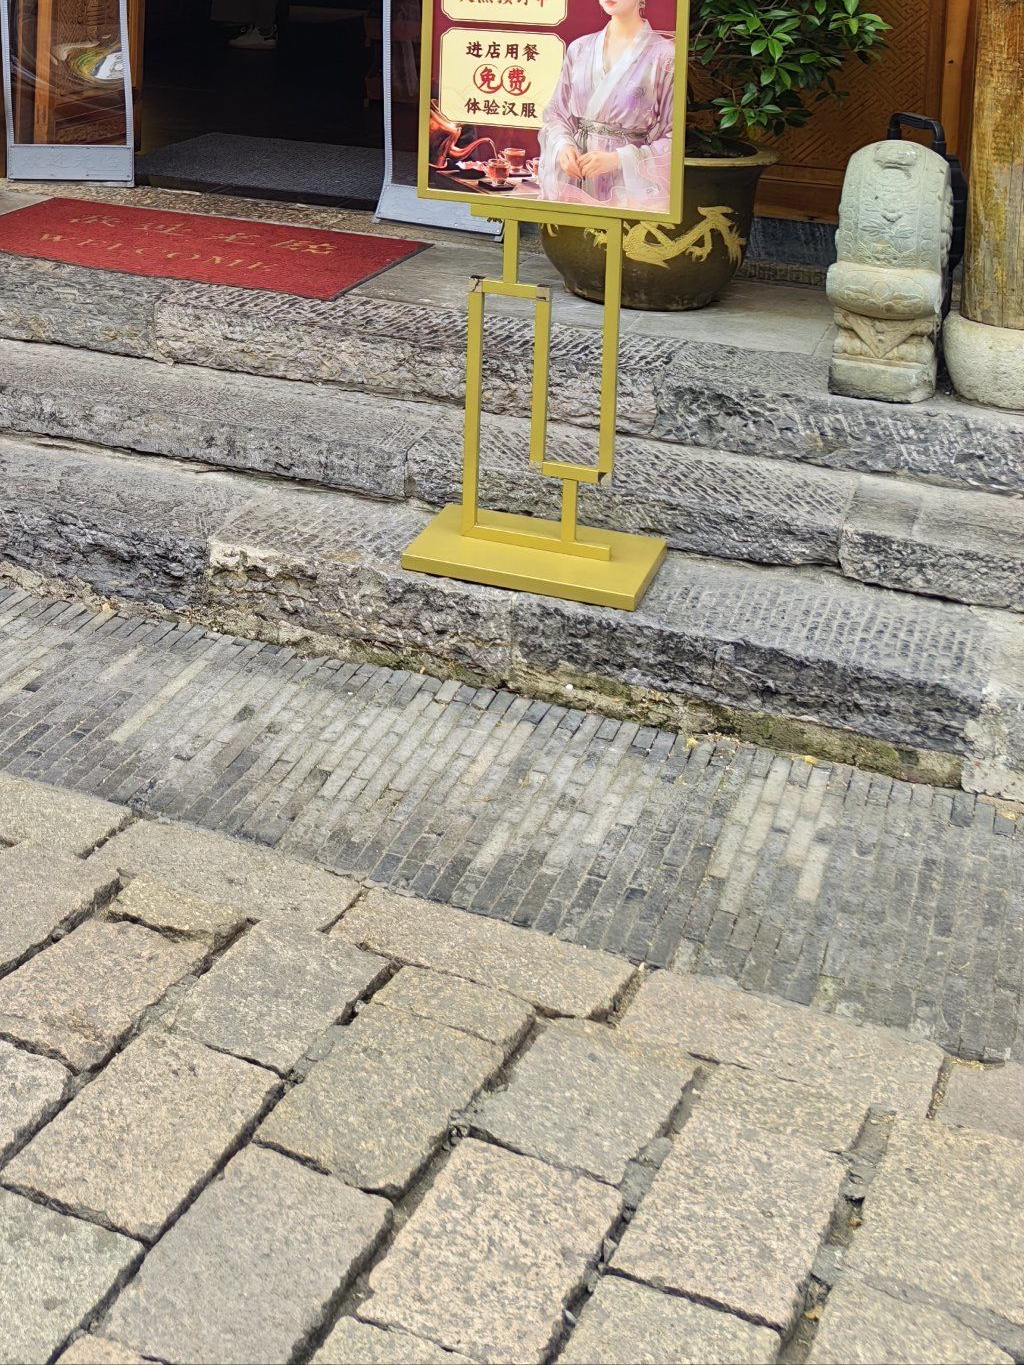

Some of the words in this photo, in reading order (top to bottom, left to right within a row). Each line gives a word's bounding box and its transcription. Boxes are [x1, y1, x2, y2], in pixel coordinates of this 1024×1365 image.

[465, 40, 540, 62] 进店用餐
[476, 66, 529, 95] 免费
[464, 97, 538, 119] 体验汉服
